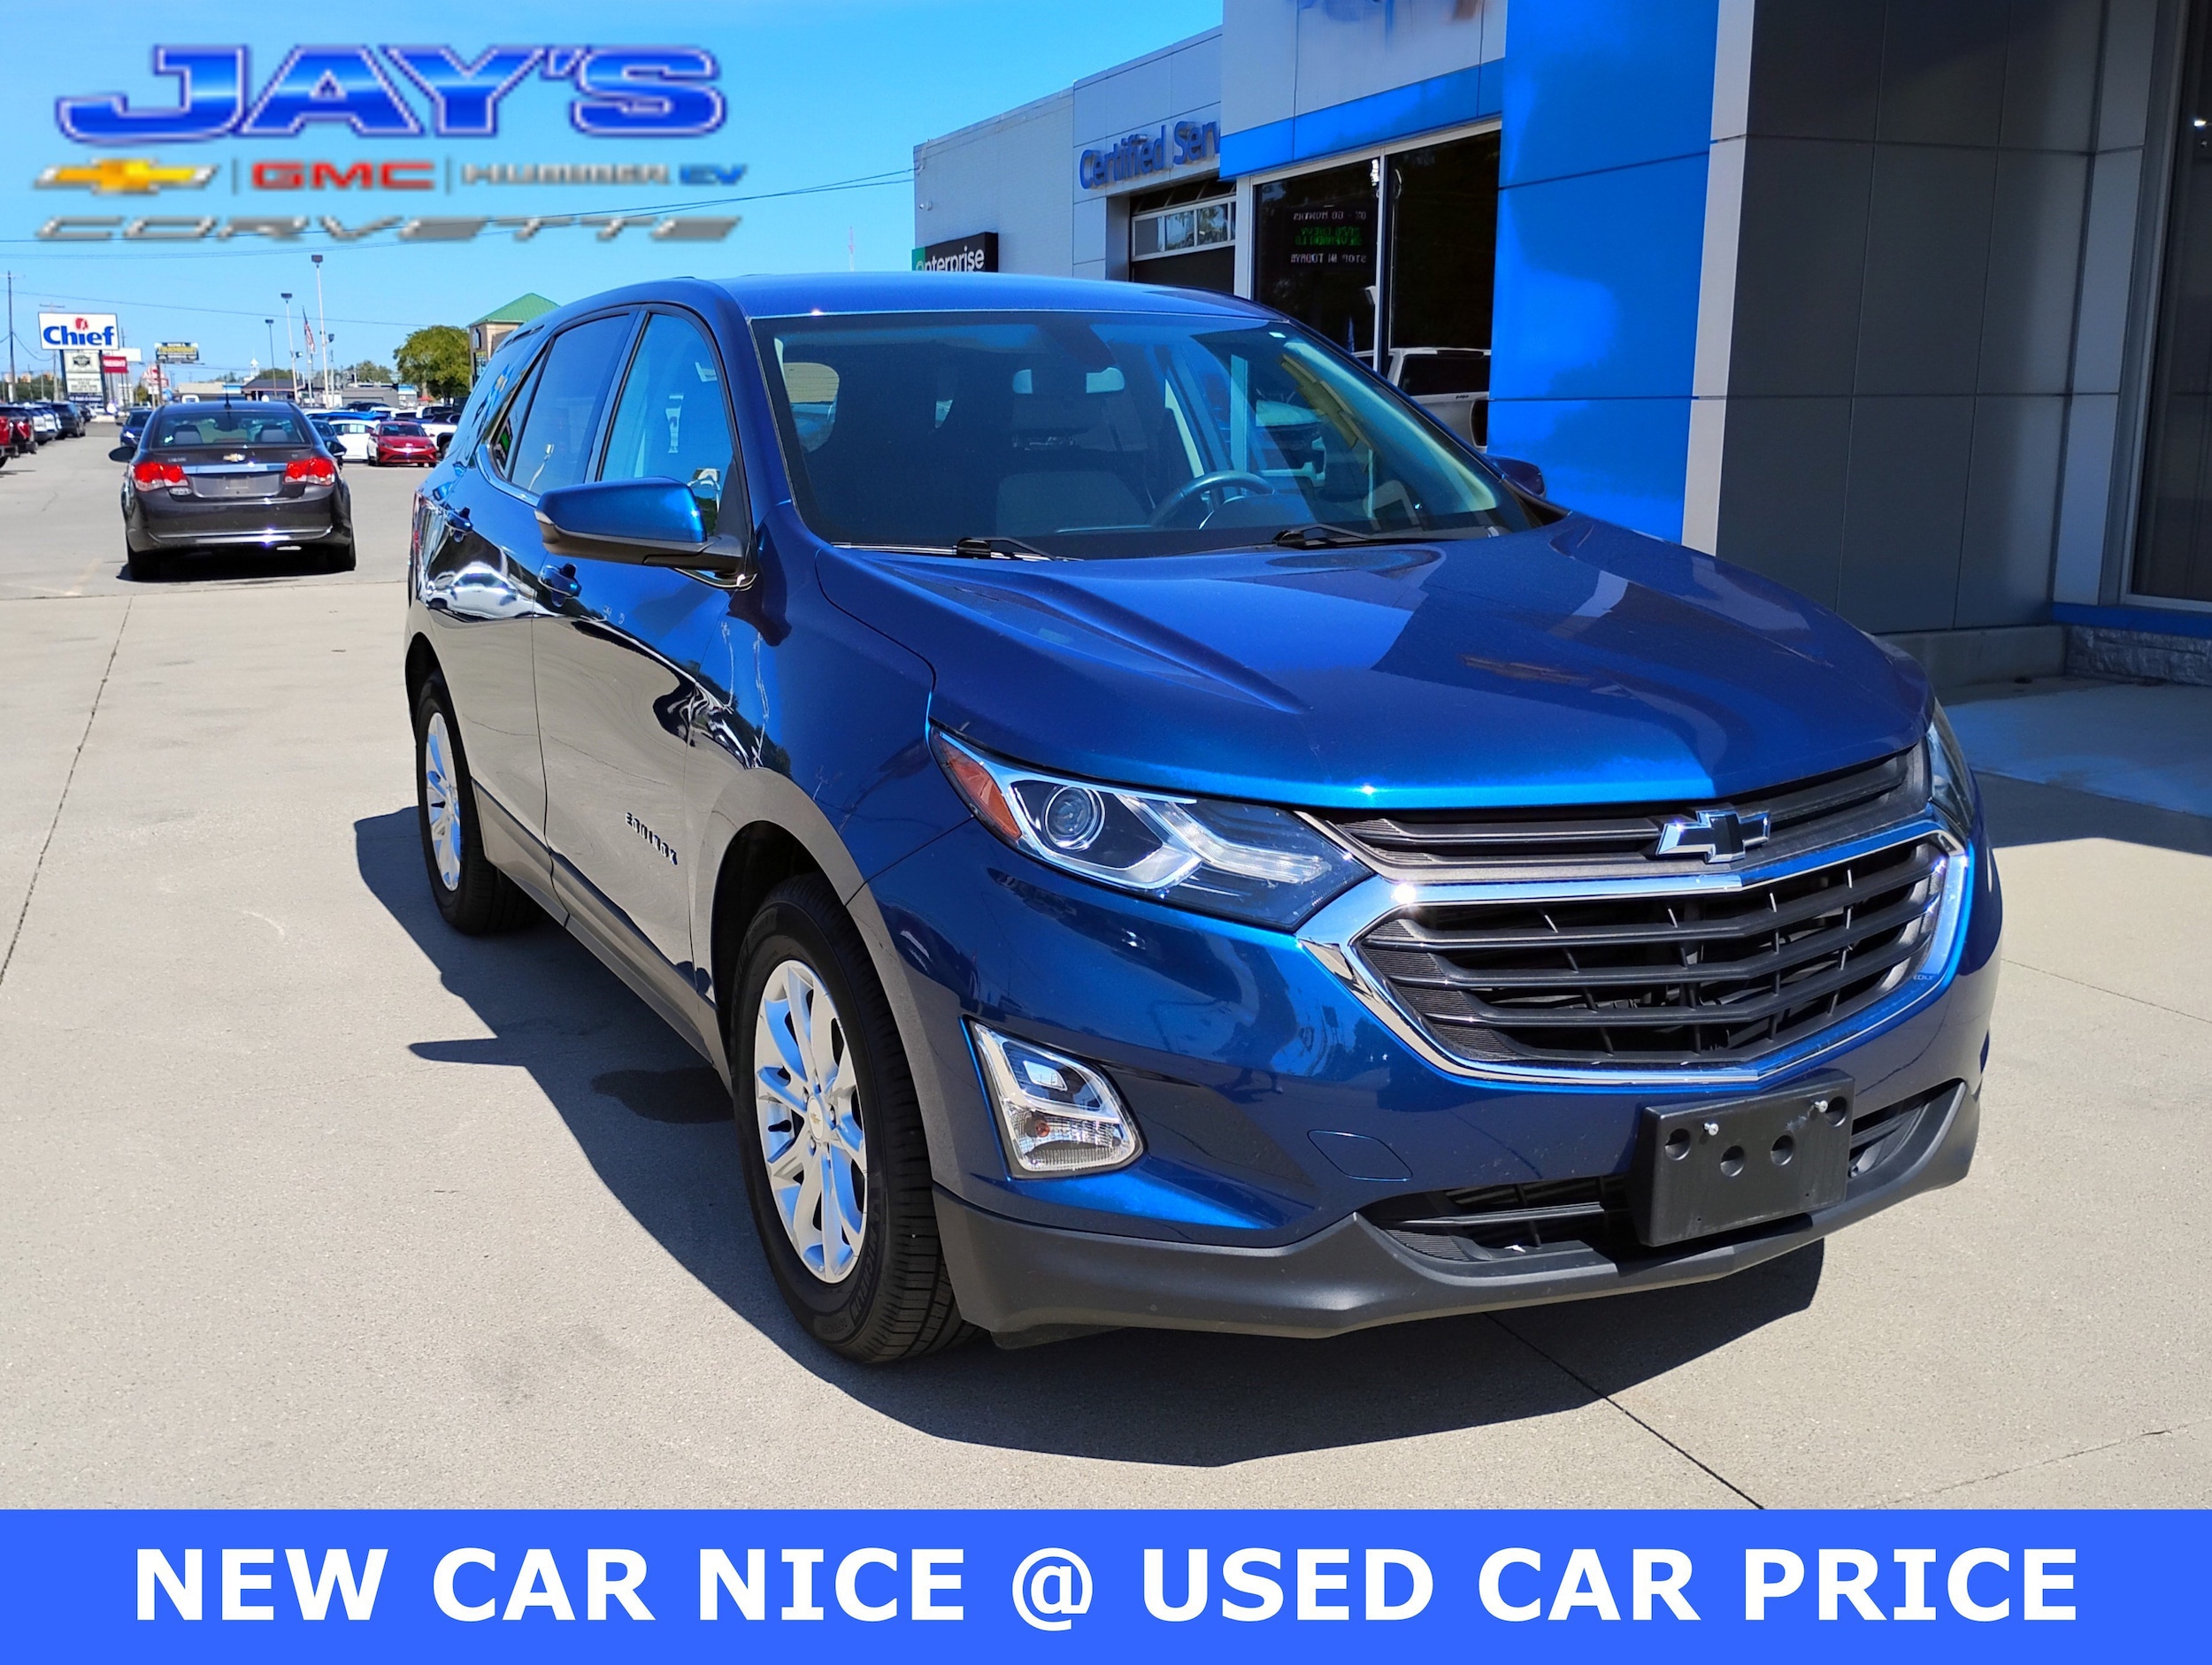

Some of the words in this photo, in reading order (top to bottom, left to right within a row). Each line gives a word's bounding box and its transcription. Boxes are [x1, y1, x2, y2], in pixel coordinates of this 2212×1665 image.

[1080, 125, 1169, 189] Certified
[916, 245, 984, 272] enterprise
[42, 326, 115, 346] Chief
[625, 812, 678, 865] EQUINOX
